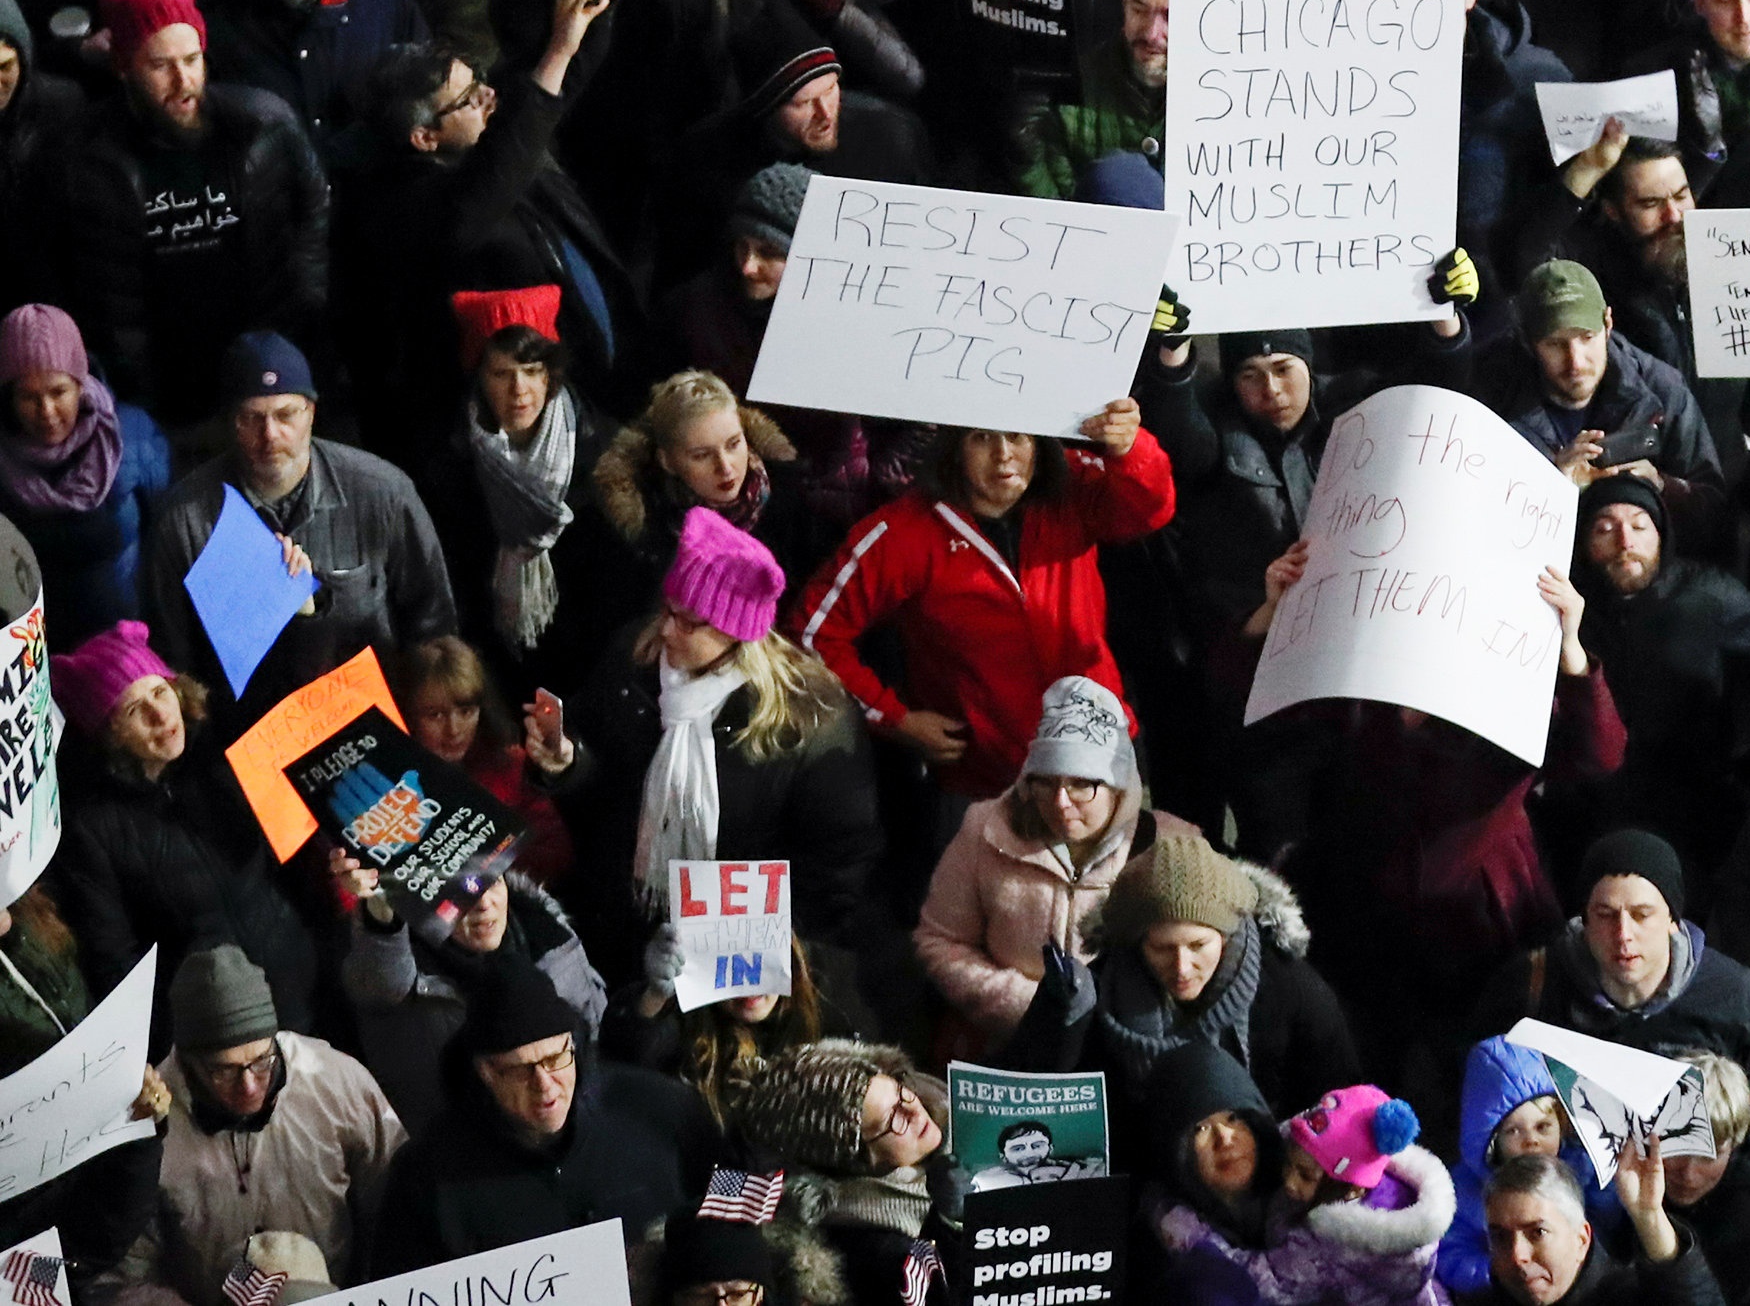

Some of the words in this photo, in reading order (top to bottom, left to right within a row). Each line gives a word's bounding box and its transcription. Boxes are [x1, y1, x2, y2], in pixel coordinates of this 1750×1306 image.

[1195, 67, 1422, 124] STANDS
[1186, 138, 1286, 178] WITH
[1315, 130, 1401, 169] OUR
[834, 188, 1110, 271] RESIST
[1186, 178, 1401, 232] MUSLIM
[1184, 232, 1438, 286] BROTHERS
[794, 255, 904, 311] THE
[933, 272, 1152, 355] FASCIST
[1714, 305, 1725, 327] I
[892, 326, 1026, 396] PIG
[1322, 411, 1376, 494] Do
[1407, 412, 1487, 480] the
[1503, 477, 1564, 550] right
[1325, 493, 1407, 559] thing
[1349, 567, 1469, 636] THEM
[300, 772, 316, 793] I
[310, 741, 366, 782] PLEDGE
[341, 780, 420, 850] PROTECT
[366, 797, 443, 867] DEFEND
[393, 853, 423, 881] OUR
[418, 806, 474, 856] STUDENTS
[407, 865, 436, 892] OUR
[429, 827, 472, 866] SCHOOL
[420, 875, 447, 902] OUR
[440, 819, 498, 877] COMMUNITY
[678, 862, 788, 918] LET
[677, 916, 789, 954] THEM
[714, 951, 763, 991] IN
[956, 1079, 1097, 1104] REFUGEES
[957, 1101, 985, 1114] ARE
[988, 1104, 1057, 1117] WELCOME
[1059, 1102, 1098, 1114] HERE
[974, 1224, 1051, 1250] Stop
[973, 1250, 1113, 1288] profiling
